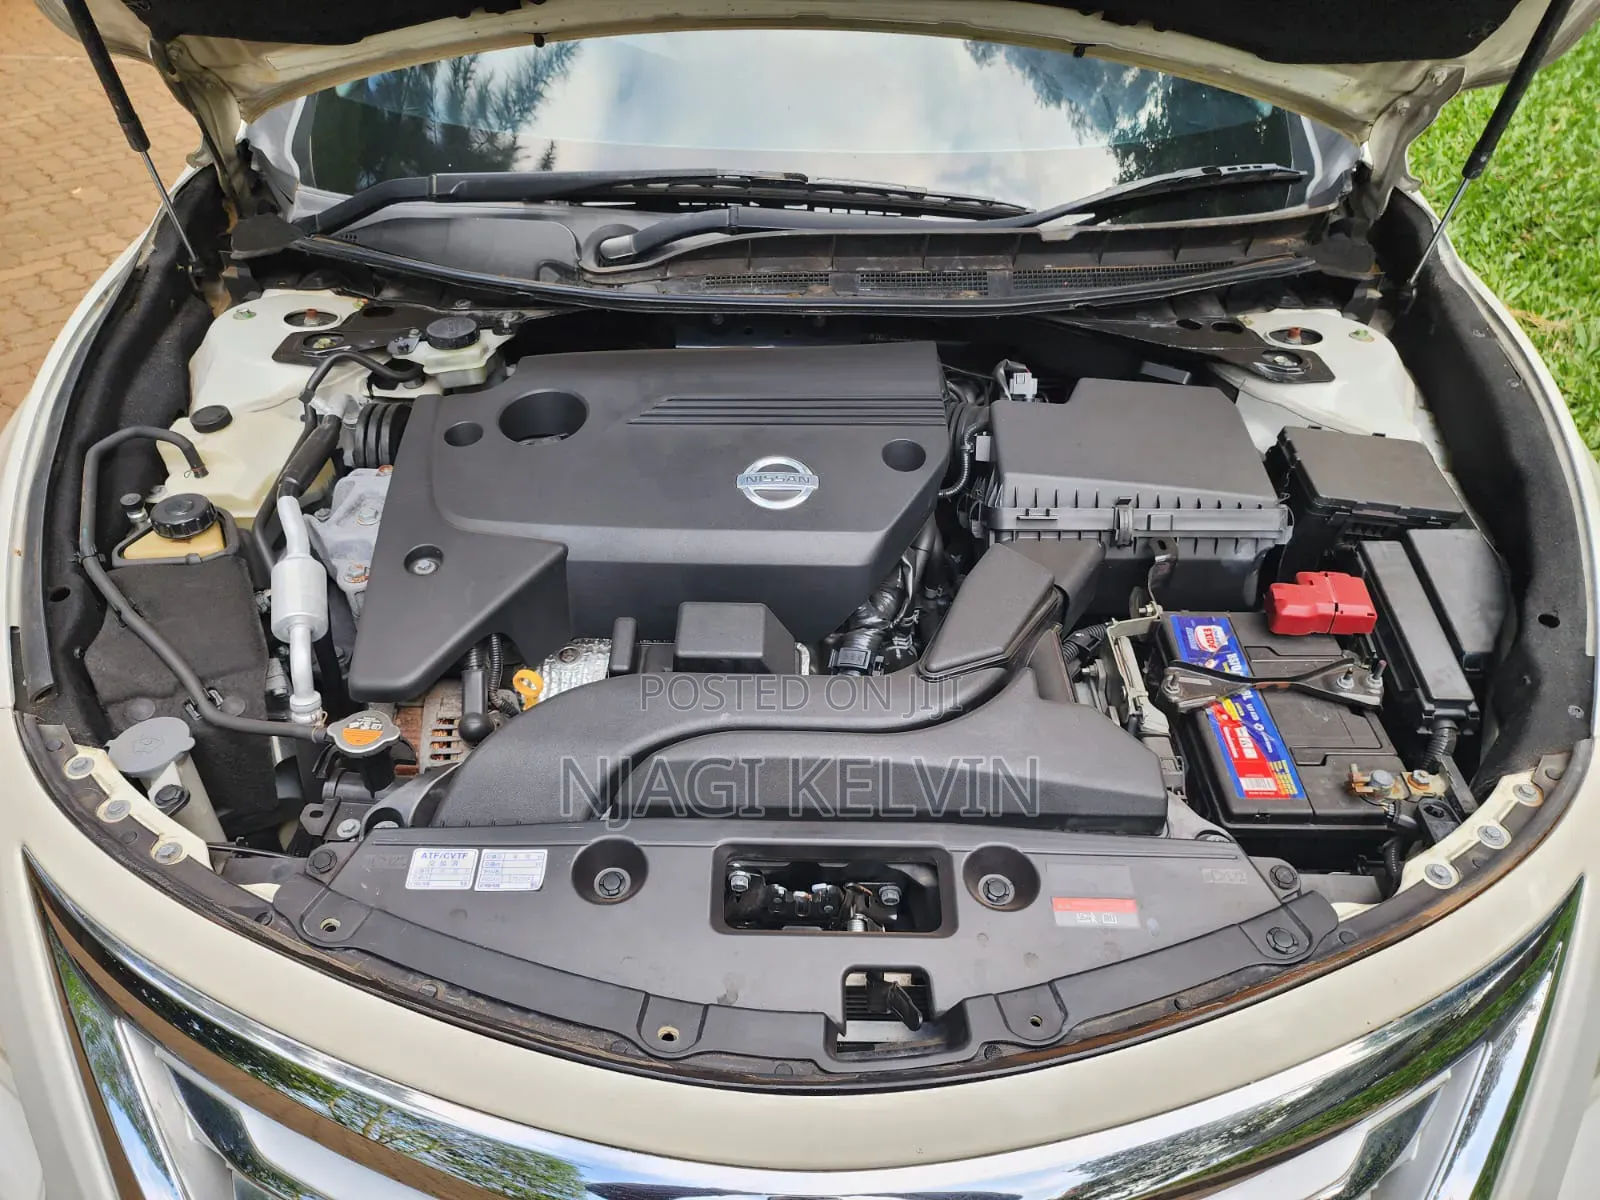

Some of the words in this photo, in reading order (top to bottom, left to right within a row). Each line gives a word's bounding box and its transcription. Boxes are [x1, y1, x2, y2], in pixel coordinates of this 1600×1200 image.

[746, 475, 810, 484] NISSAN
[1203, 628, 1217, 649] EXIDE
[421, 852, 468, 860] ATF/CVTF
